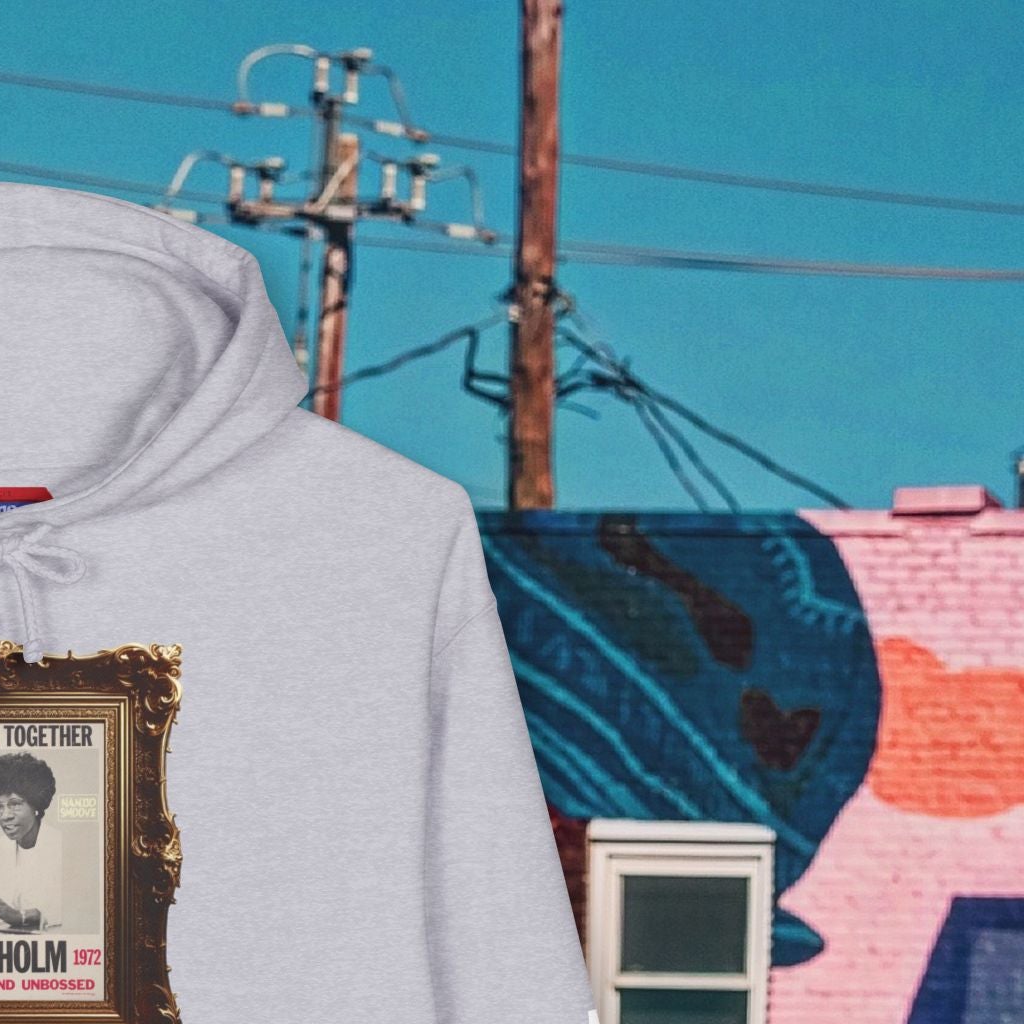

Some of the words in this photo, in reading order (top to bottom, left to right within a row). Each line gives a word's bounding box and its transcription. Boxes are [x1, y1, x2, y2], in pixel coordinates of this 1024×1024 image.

[3, 724, 93, 747] TOGETHER
[73, 949, 102, 966] 1972
[21, 979, 96, 991] UNBOSSED
